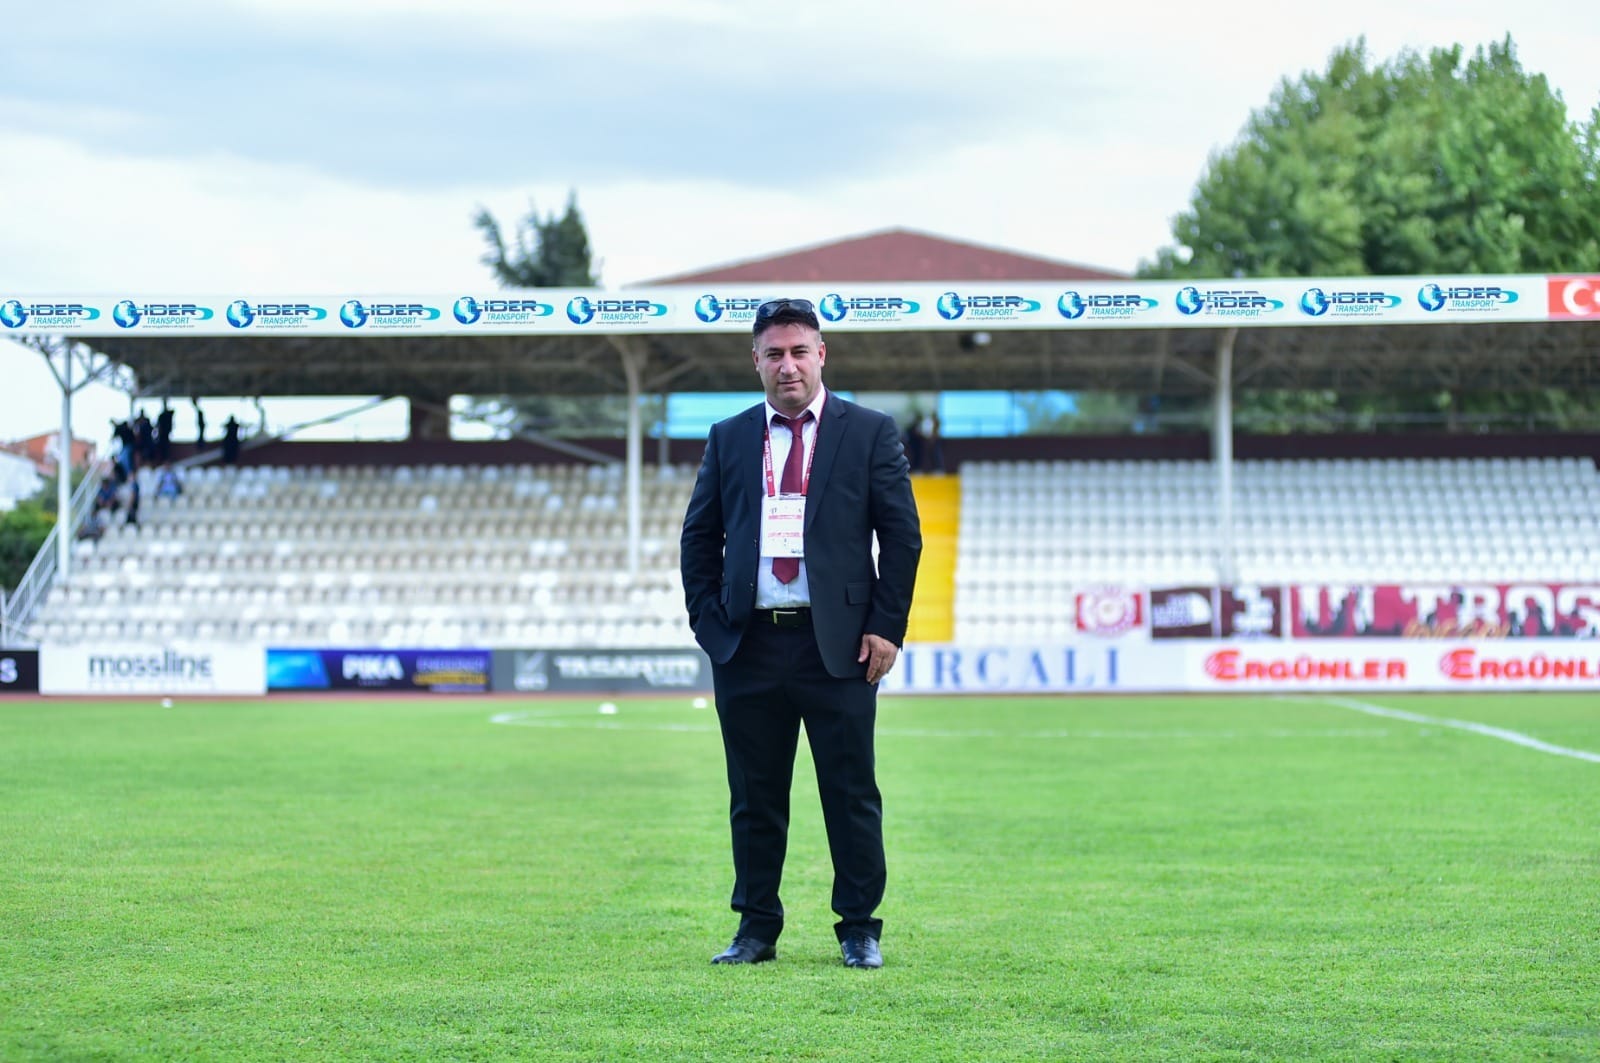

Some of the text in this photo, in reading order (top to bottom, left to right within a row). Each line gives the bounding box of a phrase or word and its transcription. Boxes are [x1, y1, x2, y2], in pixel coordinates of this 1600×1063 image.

[1452, 300, 1495, 308] TRANSPORT
[1091, 308, 1135, 316] TRANSPORT
[1217, 309, 1260, 317] TRANSPORT
[1335, 305, 1378, 313] TRANSPORT
[600, 313, 644, 321] TRANSPORT
[729, 311, 755, 319] TRANS
[853, 310, 896, 318] TRANSPORT
[33, 317, 77, 325] TRANSPORT
[147, 317, 190, 325] TRANSPORT
[260, 317, 303, 325] TRANSPORT
[374, 317, 417, 325] TRANSPORT
[342, 654, 404, 680] PIKA
[881, 648, 1119, 687] IRCALI
[1207, 649, 1406, 681] ERGÜNLER
[1441, 648, 1600, 680] ERGÜNL
